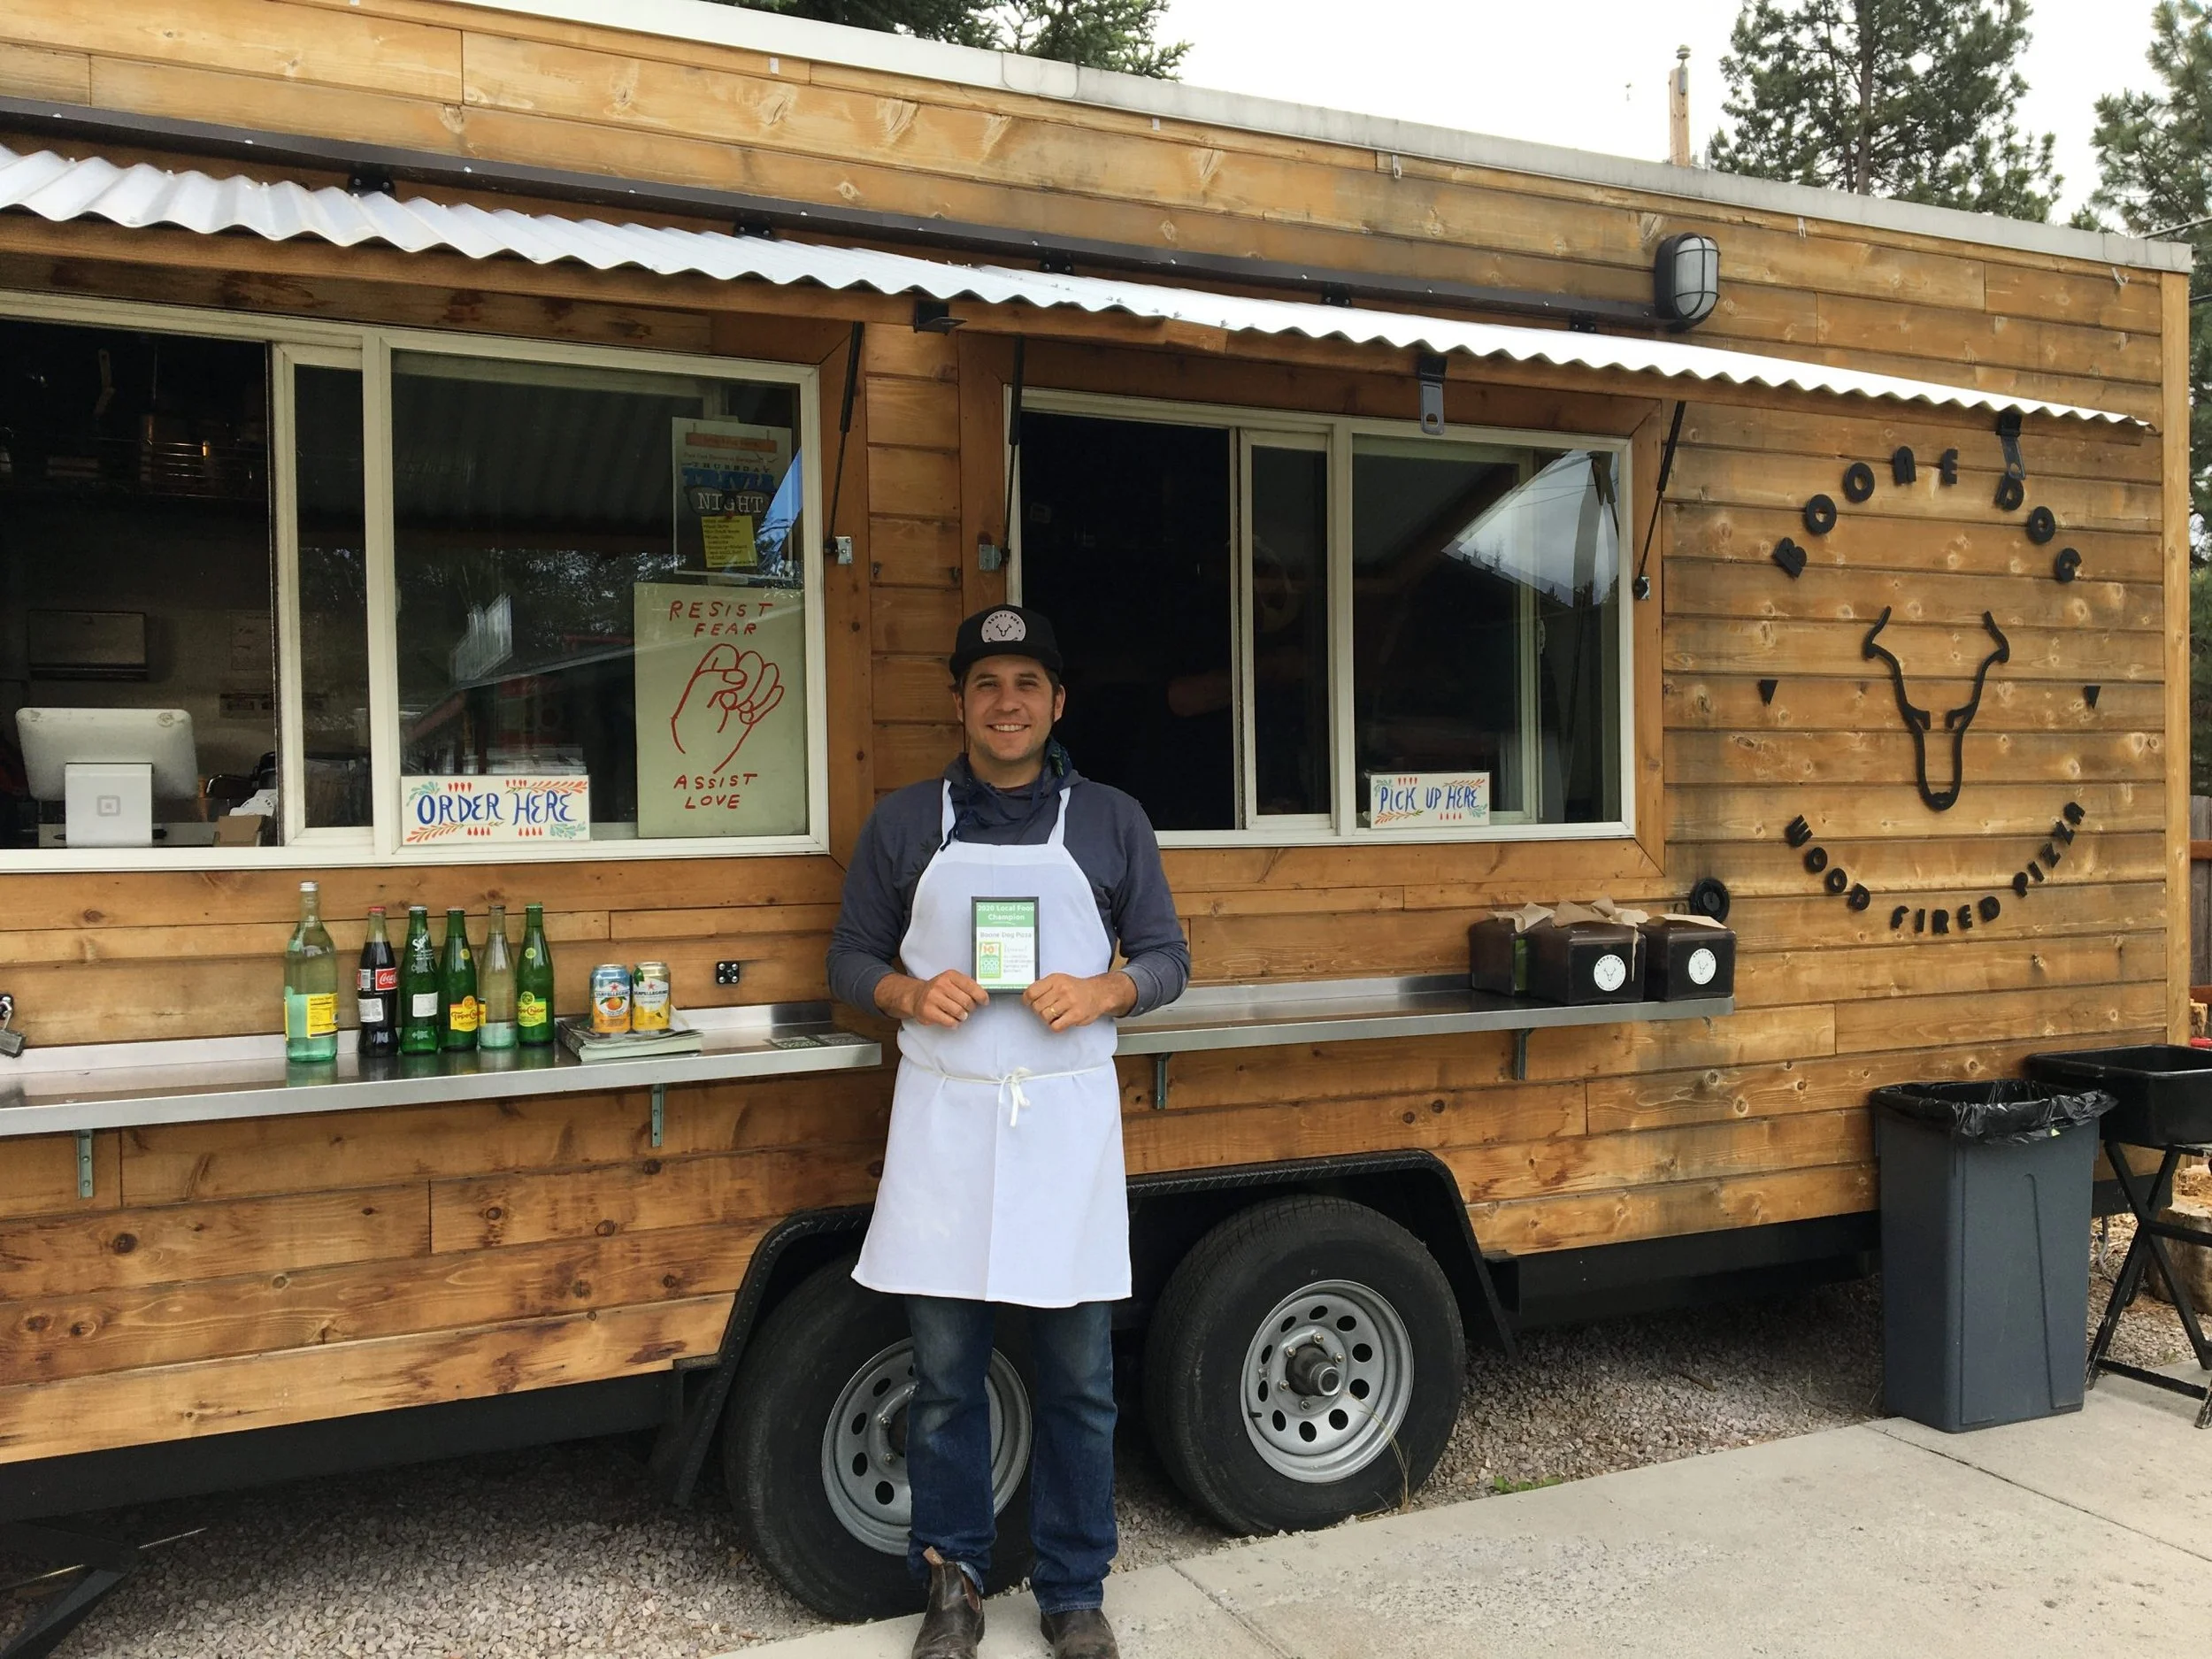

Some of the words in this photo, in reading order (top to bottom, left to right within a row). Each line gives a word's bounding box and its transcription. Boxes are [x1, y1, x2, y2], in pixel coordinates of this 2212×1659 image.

[693, 462, 770, 474] THURSDAY
[697, 492, 764, 513] NIGHT
[1773, 445, 1959, 578] BOONE
[1995, 474, 2083, 583] DOG
[669, 599, 776, 621] RESIST
[694, 622, 757, 638] FEAR
[673, 772, 758, 790] ASSIST
[416, 791, 505, 826] ORDER
[512, 788, 579, 826] HERE
[685, 794, 741, 810] LOVE
[1379, 786, 1417, 813] PICK
[1425, 786, 1442, 810] UP
[1445, 784, 1480, 810] HERE
[1786, 815, 1871, 911] WOOD
[1890, 895, 2001, 935] FIRED
[2012, 802, 2086, 898] PIZZA
